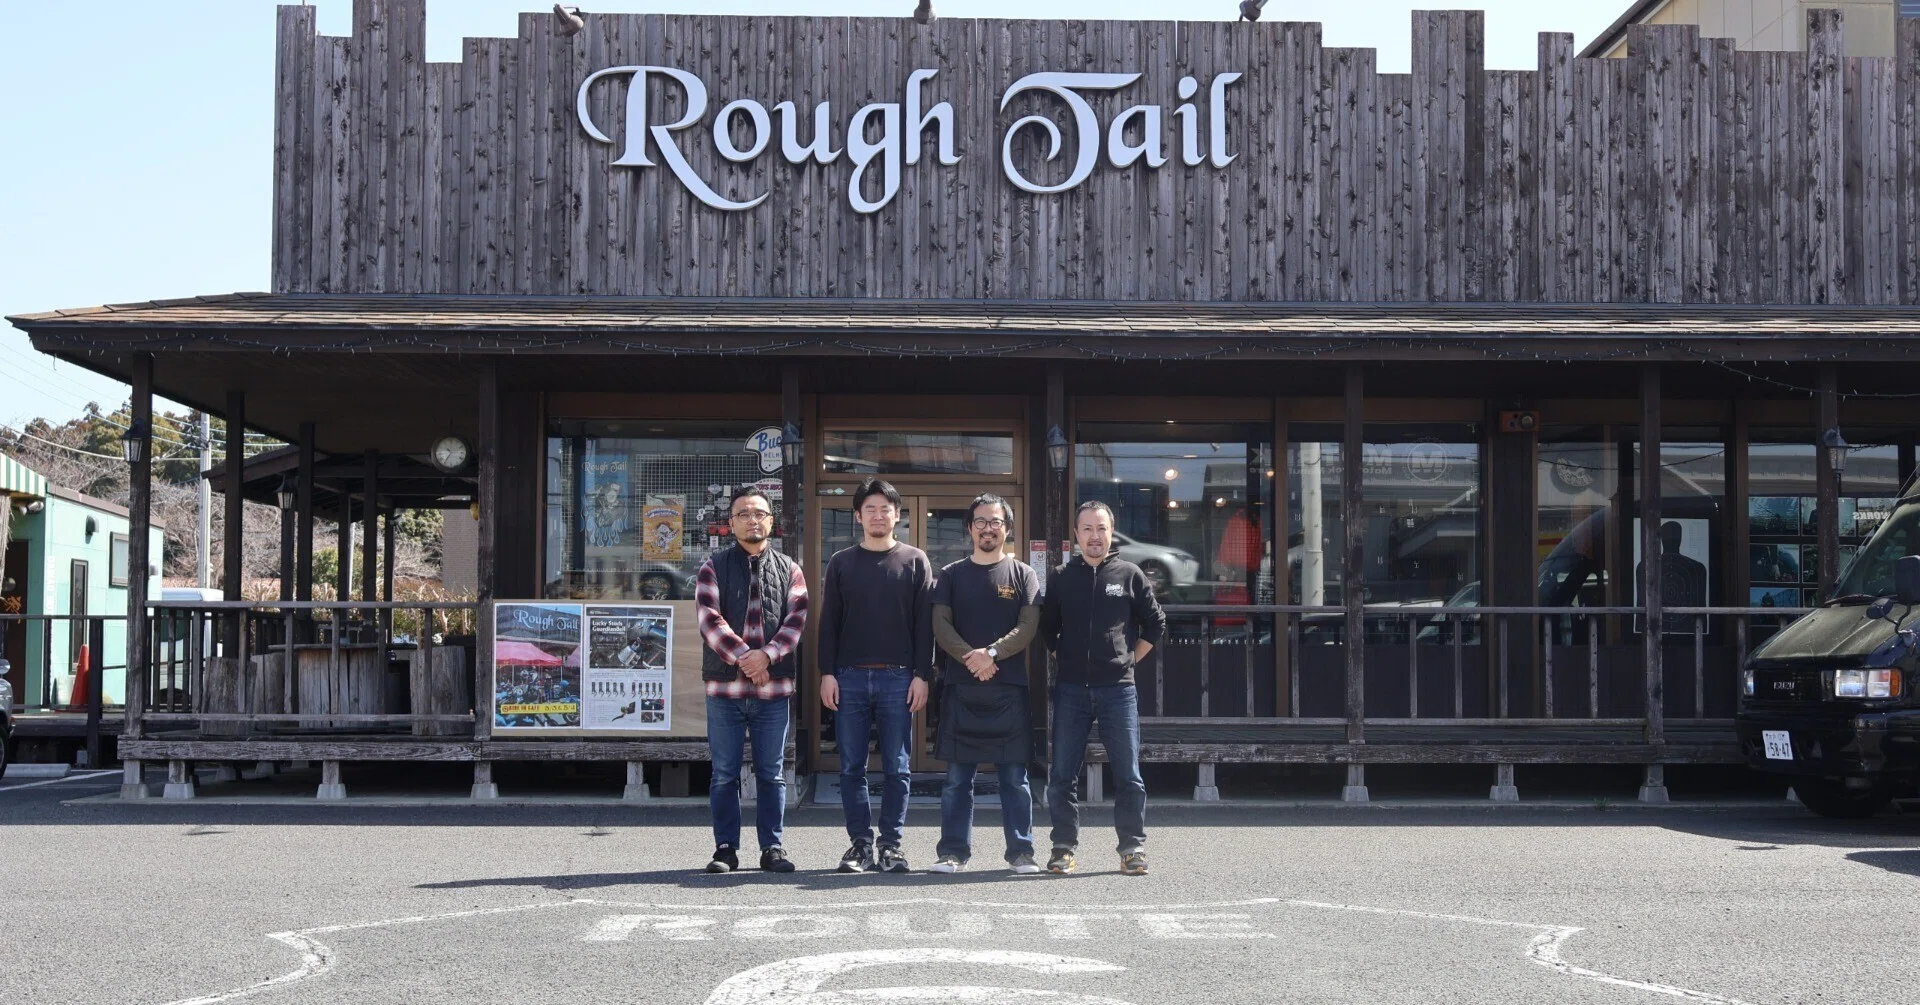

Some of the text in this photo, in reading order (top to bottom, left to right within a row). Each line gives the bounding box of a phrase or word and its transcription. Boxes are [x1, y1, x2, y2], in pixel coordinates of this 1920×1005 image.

[577, 65, 1243, 213] Rough Tail
[755, 432, 782, 452] Buc
[582, 461, 628, 474] Rough Tail
[513, 609, 580, 630] Rough Tail
[583, 912, 1277, 941] ROUTE
